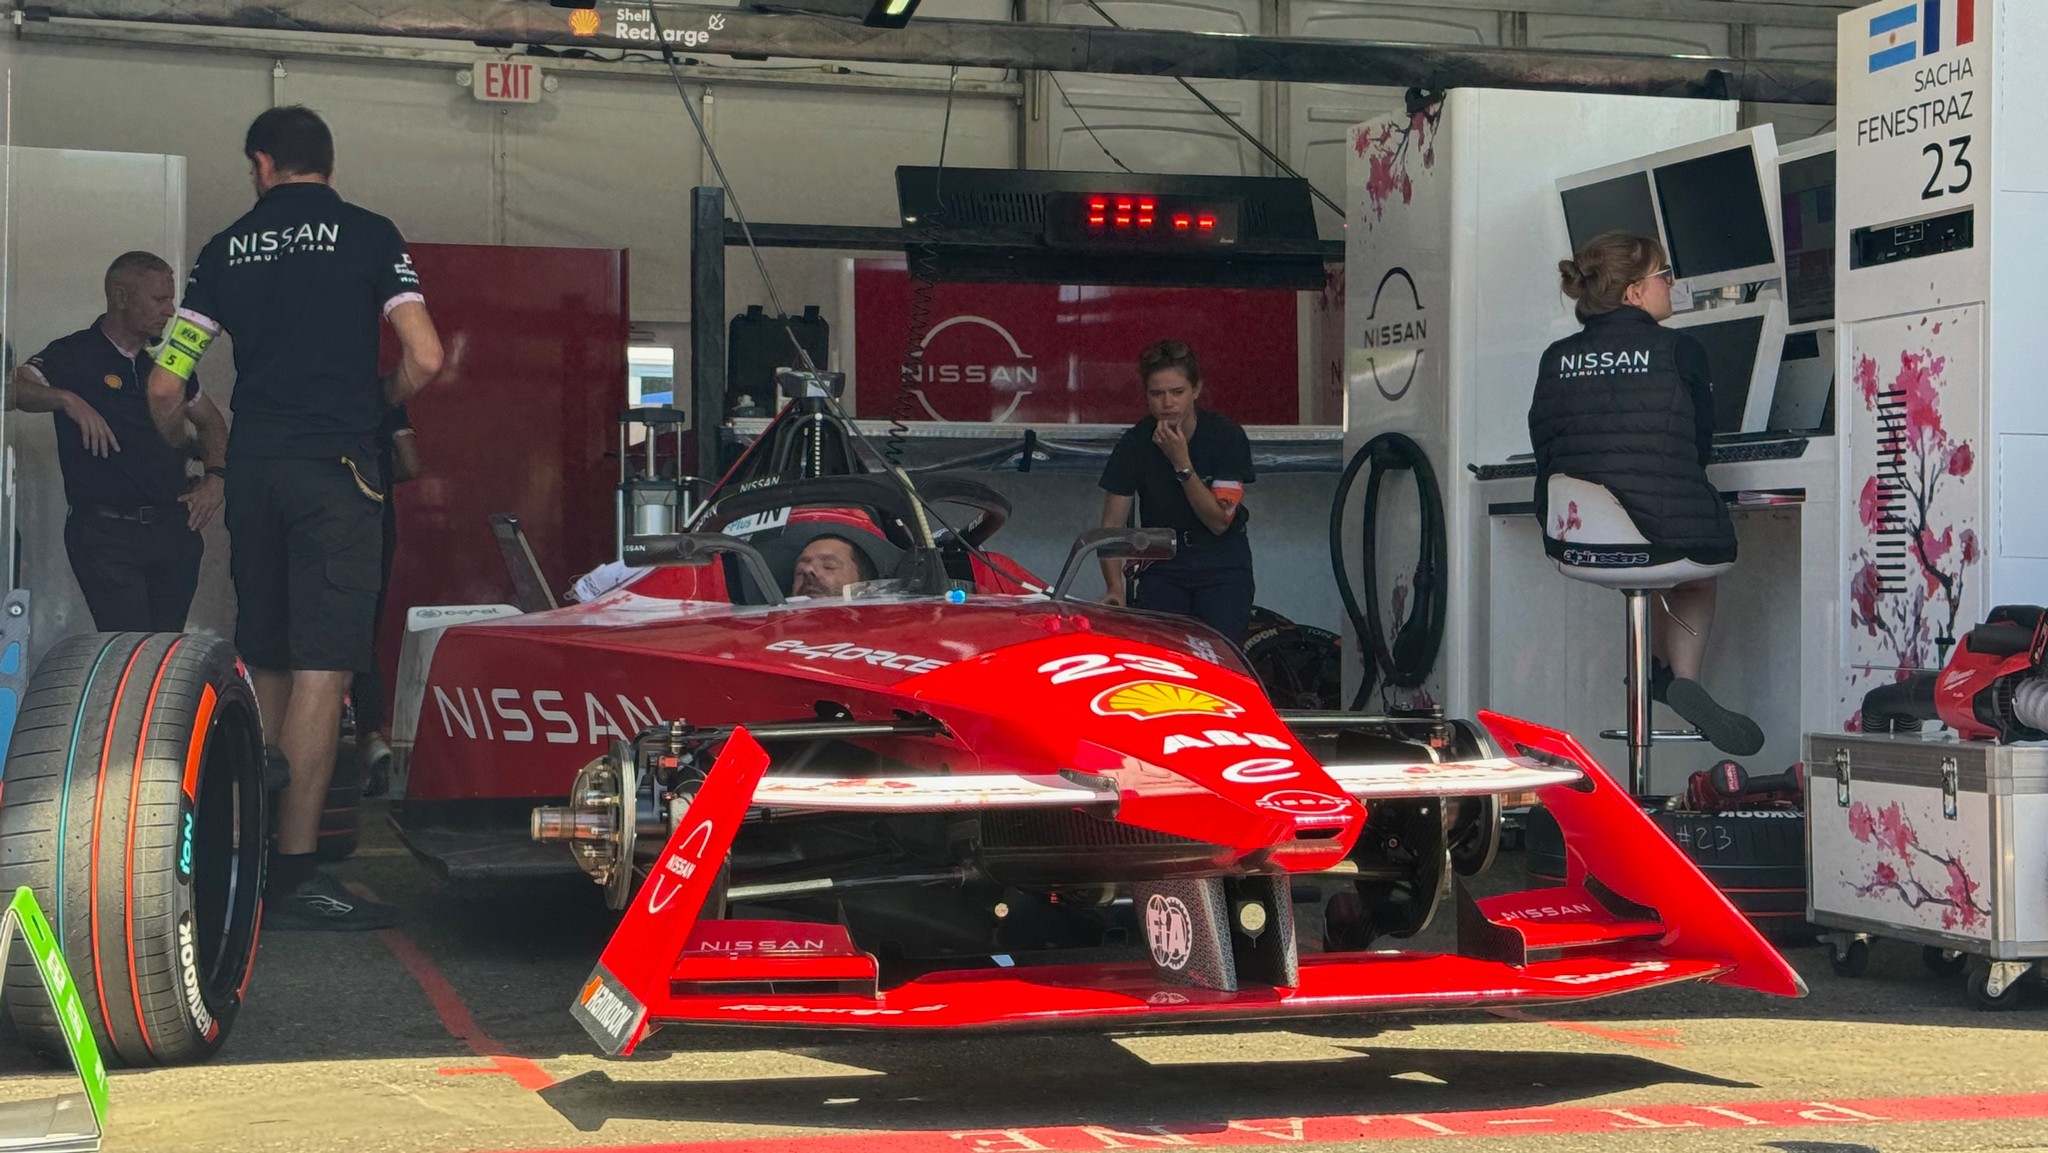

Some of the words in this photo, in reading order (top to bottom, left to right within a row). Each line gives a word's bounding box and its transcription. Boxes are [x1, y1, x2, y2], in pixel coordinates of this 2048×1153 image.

[616, 8, 650, 22] Shell
[485, 62, 533, 100] EXIT
[1914, 57, 1974, 92] SACHA
[1857, 90, 1974, 147] FENESTRAZ
[1921, 134, 1973, 201] 23
[229, 223, 339, 256] NISSAN
[301, 244, 335, 252] TEAM
[1364, 319, 1427, 349] NISSAN
[165, 354, 177, 366] 5
[1560, 350, 1650, 371] NISSAN
[901, 364, 1037, 383] NISSAN
[740, 475, 780, 493] NISSAN
[1563, 549, 1649, 565] alpinestars
[1037, 653, 1199, 685] 23
[433, 686, 663, 745] NISSAN
[1163, 729, 1291, 755] ABB
[1255, 798, 1352, 807] NISSAN
[665, 853, 697, 880] NISSAN
[1500, 903, 1593, 923] NISSAN
[700, 939, 824, 951] NISSAN
